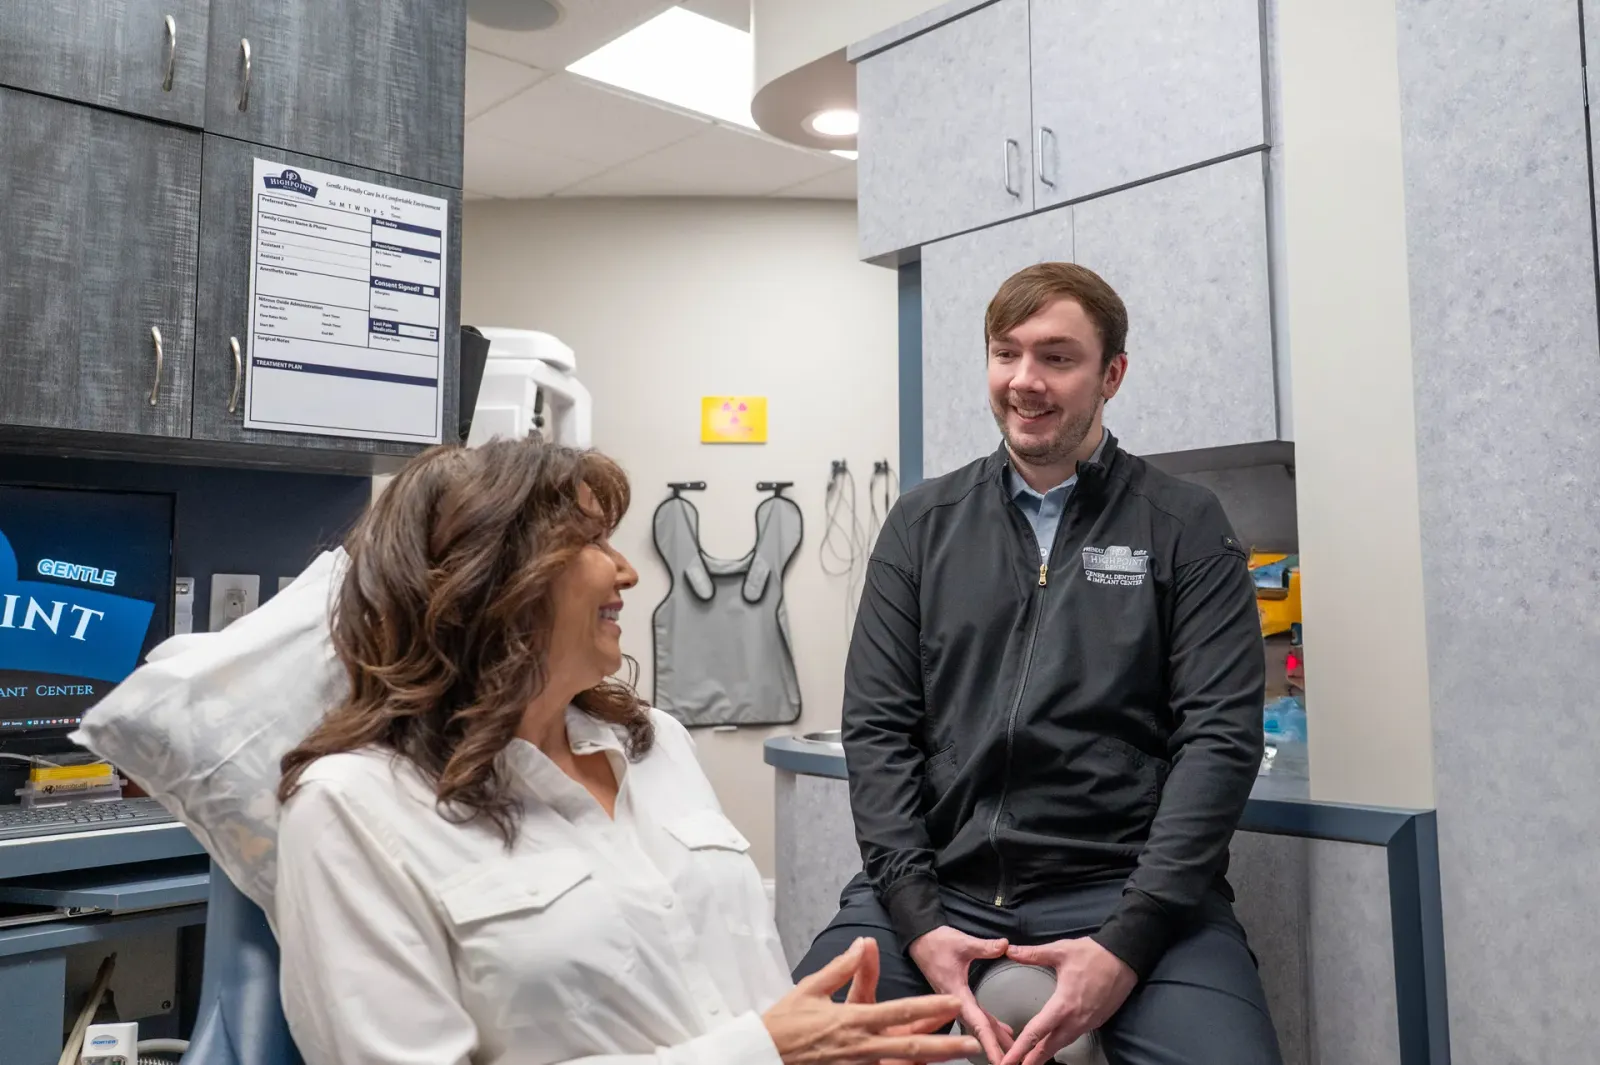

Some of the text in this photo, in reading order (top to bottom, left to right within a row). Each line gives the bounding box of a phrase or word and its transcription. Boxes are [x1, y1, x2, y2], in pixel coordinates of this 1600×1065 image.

[270, 178, 312, 192] HIGHPOINT
[262, 197, 283, 206] Preferred
[326, 182, 342, 190] Gentle,
[343, 186, 363, 195] Friendly
[364, 189, 375, 198] Care
[384, 194, 412, 204] Comfortable
[413, 201, 441, 211] Environment
[260, 266, 284, 274] Anesthetic
[374, 280, 420, 292] Consent Signed?
[290, 302, 323, 310] Administration
[256, 360, 287, 368] TREATMENT
[1090, 555, 1143, 566] HIGHPOINT
[38, 558, 116, 586] GENTLE
[1085, 570, 1113, 580] GENERAL
[36, 685, 94, 696] CENTER
